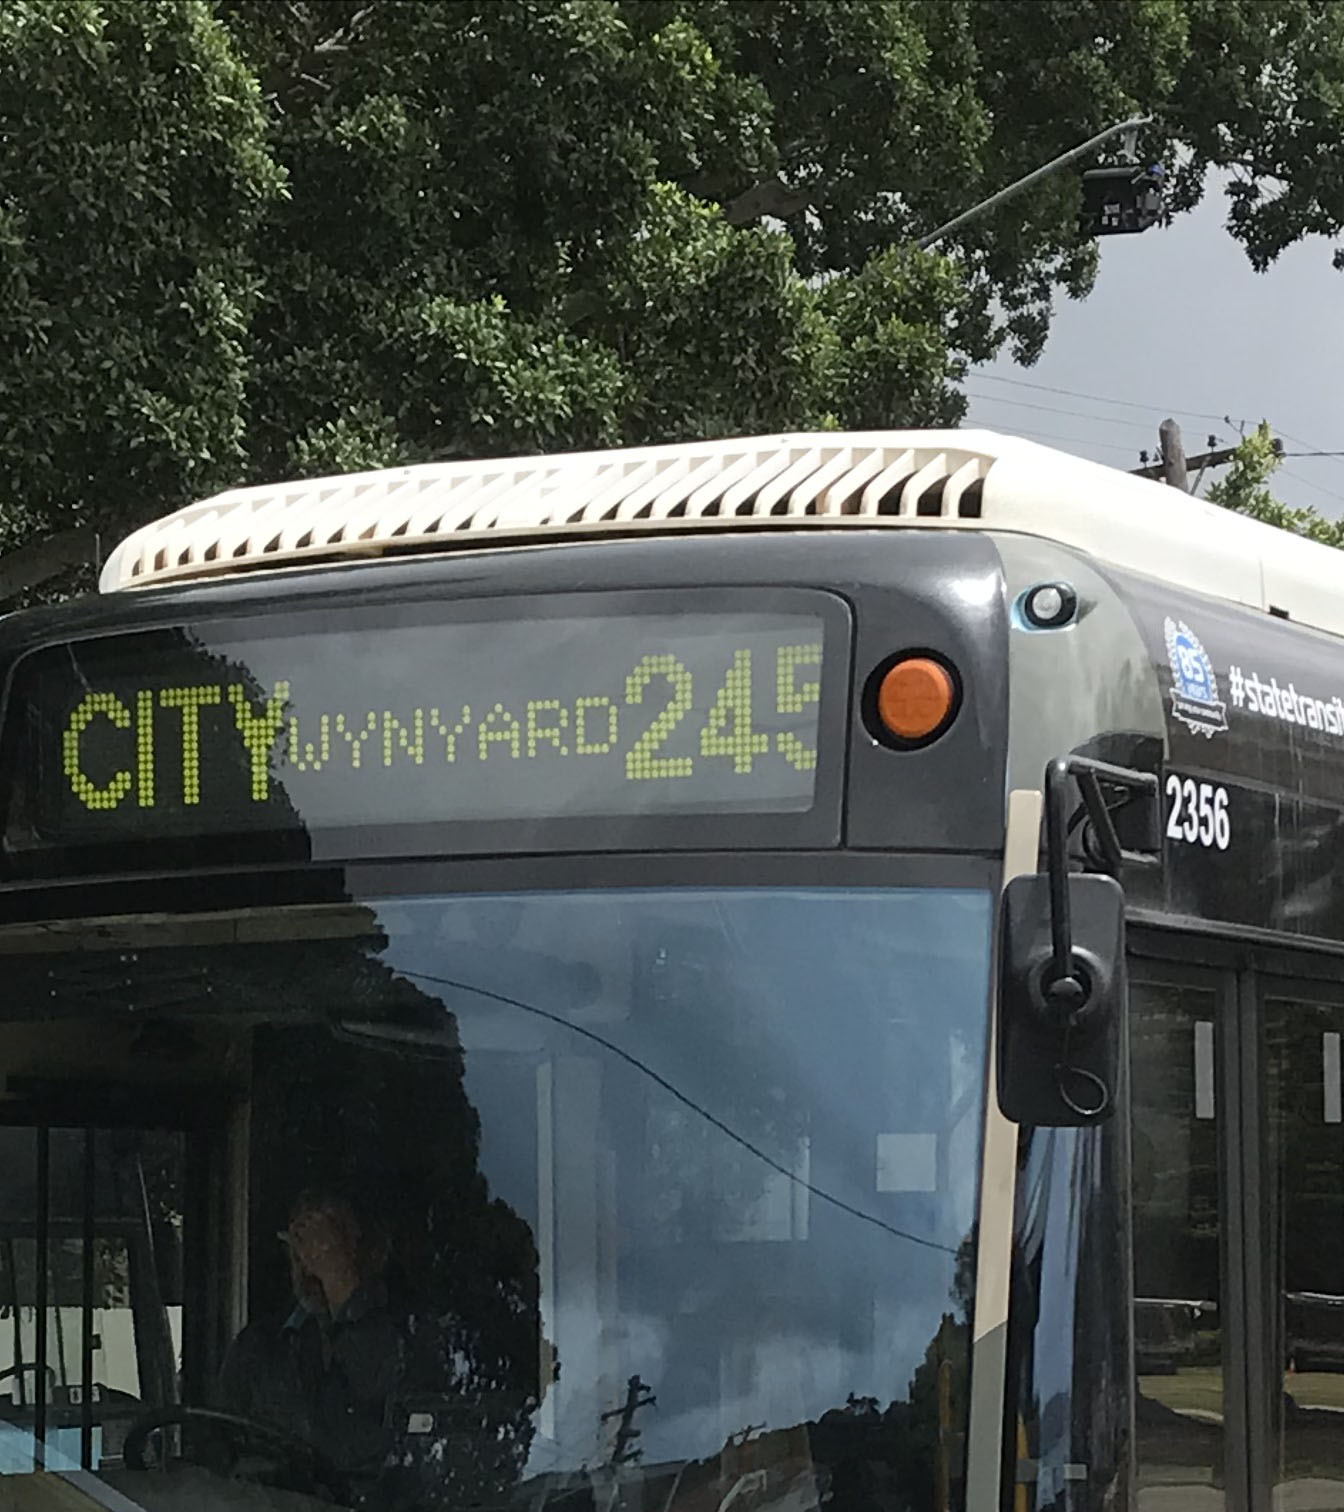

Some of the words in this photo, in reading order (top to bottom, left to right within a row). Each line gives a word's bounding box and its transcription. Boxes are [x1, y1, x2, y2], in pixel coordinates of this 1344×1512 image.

[61, 680, 292, 811] CITY
[287, 696, 619, 773] WYNYARD
[624, 643, 822, 781] 245
[1165, 774, 1230, 850] 2356
